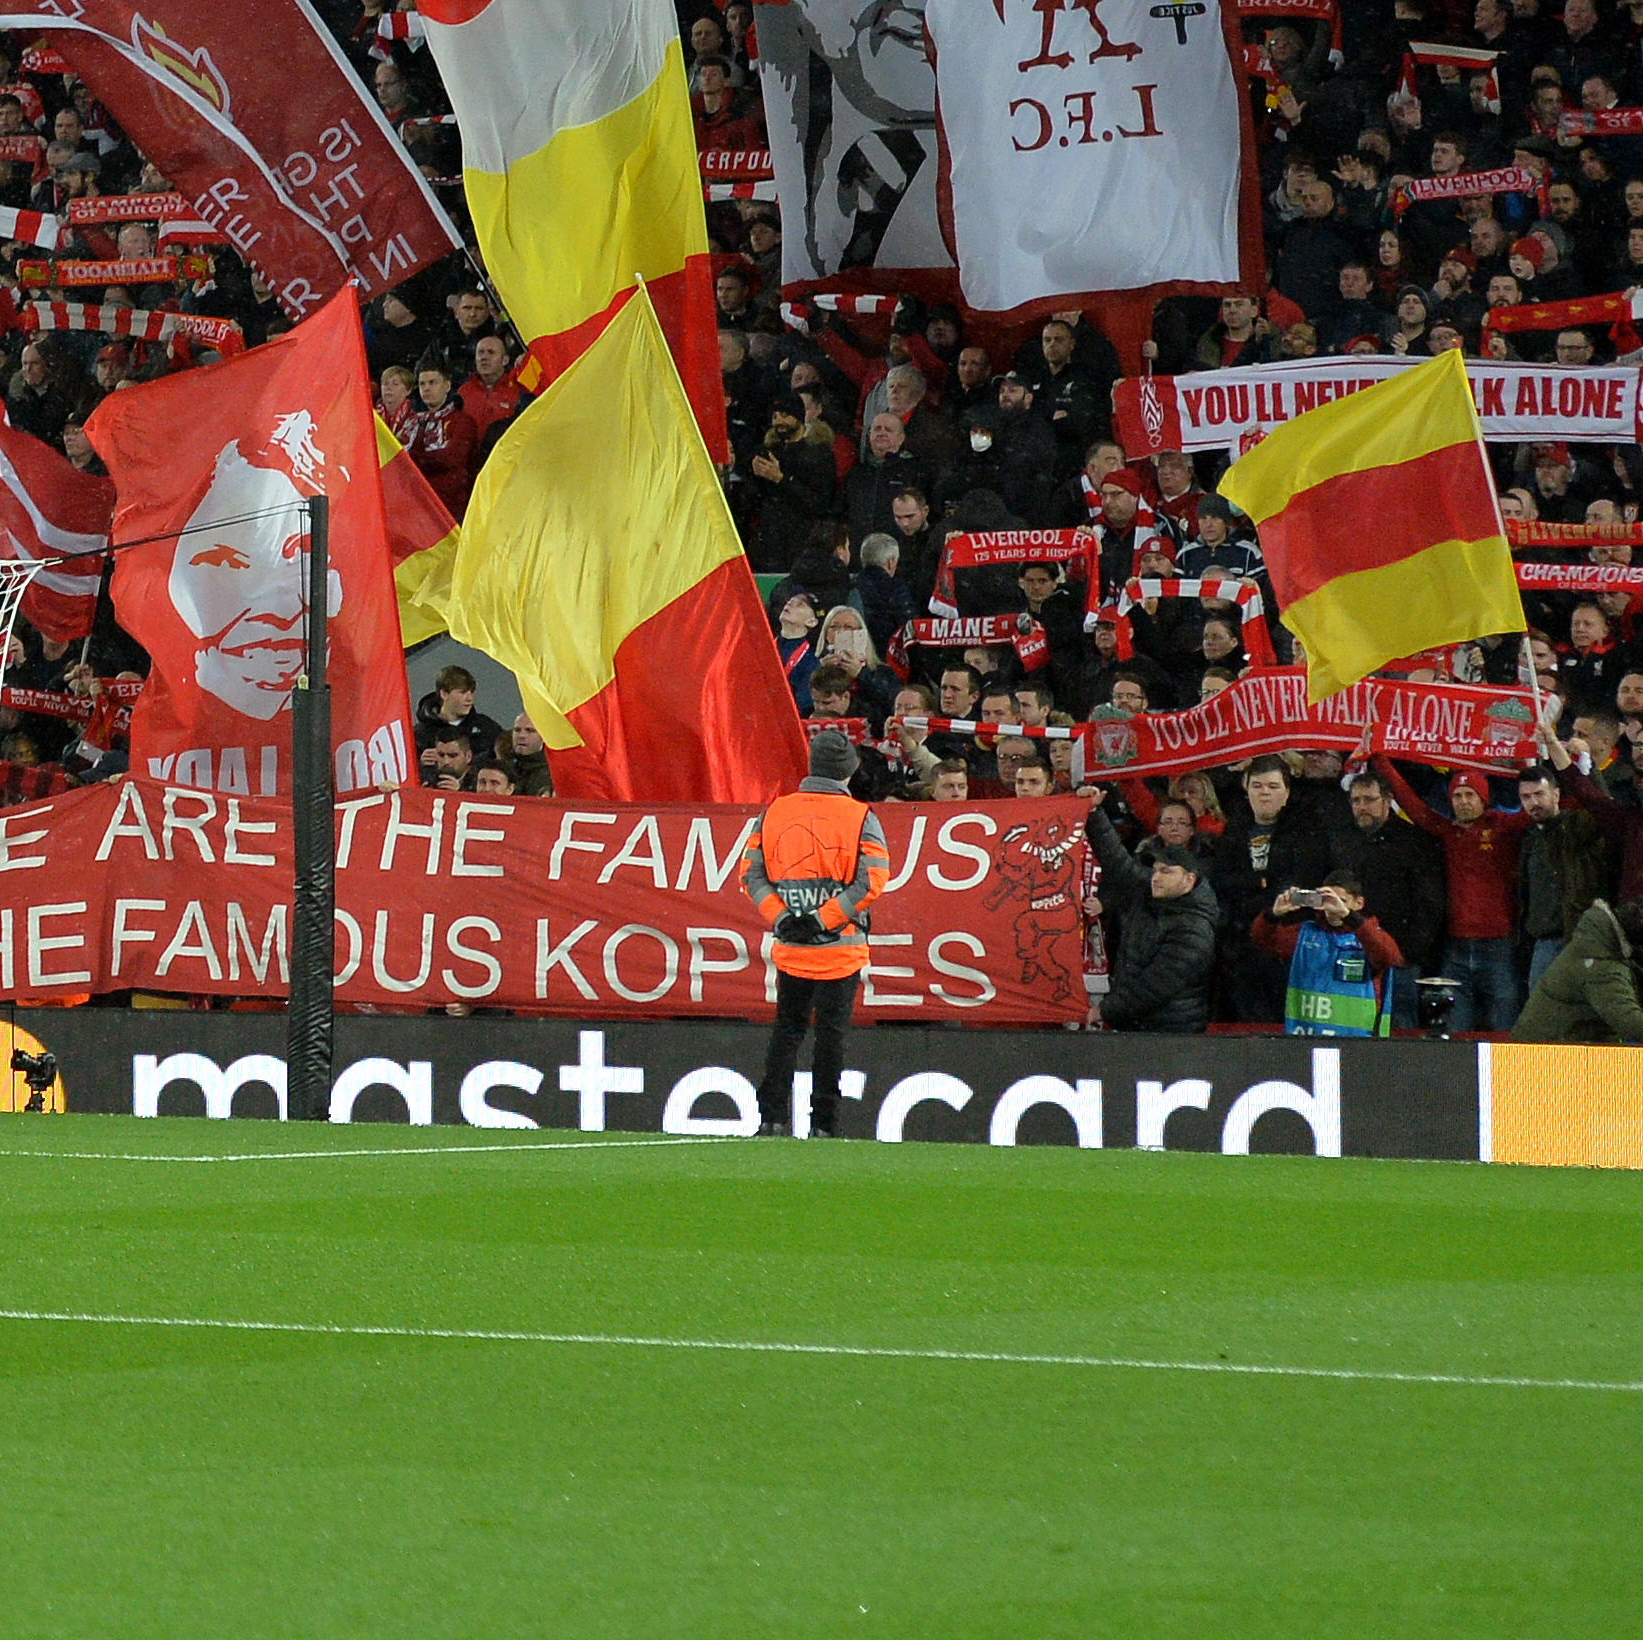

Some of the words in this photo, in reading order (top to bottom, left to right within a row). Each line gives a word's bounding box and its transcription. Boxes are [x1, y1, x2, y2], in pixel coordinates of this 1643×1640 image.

[1418, 168, 1530, 194] LIVERPOOL
[1514, 375, 1628, 419] ALONE
[969, 529, 1065, 550] LIVERPOOL
[1071, 532, 1095, 549] FC
[1531, 521, 1637, 540] LIVERPOOL
[992, 548, 1028, 561] YEARS
[1028, 547, 1043, 558] OF
[1520, 563, 1643, 584] CHAMPIONS
[930, 615, 997, 640] MANE
[1218, 674, 1310, 736] NEVER
[1314, 679, 1381, 726] WALK
[1390, 686, 1475, 740] ALONE
[1416, 742, 1443, 753] NEVER
[1449, 745, 1476, 755] WALK
[1483, 746, 1517, 757] ALONE
[94, 780, 278, 867] ARE
[334, 794, 515, 878] THE
[547, 812, 999, 893] FAMUS
[111, 896, 503, 999] FAMOUS
[534, 917, 997, 1009] KOPIES
[1300, 993, 1333, 1020] HB
